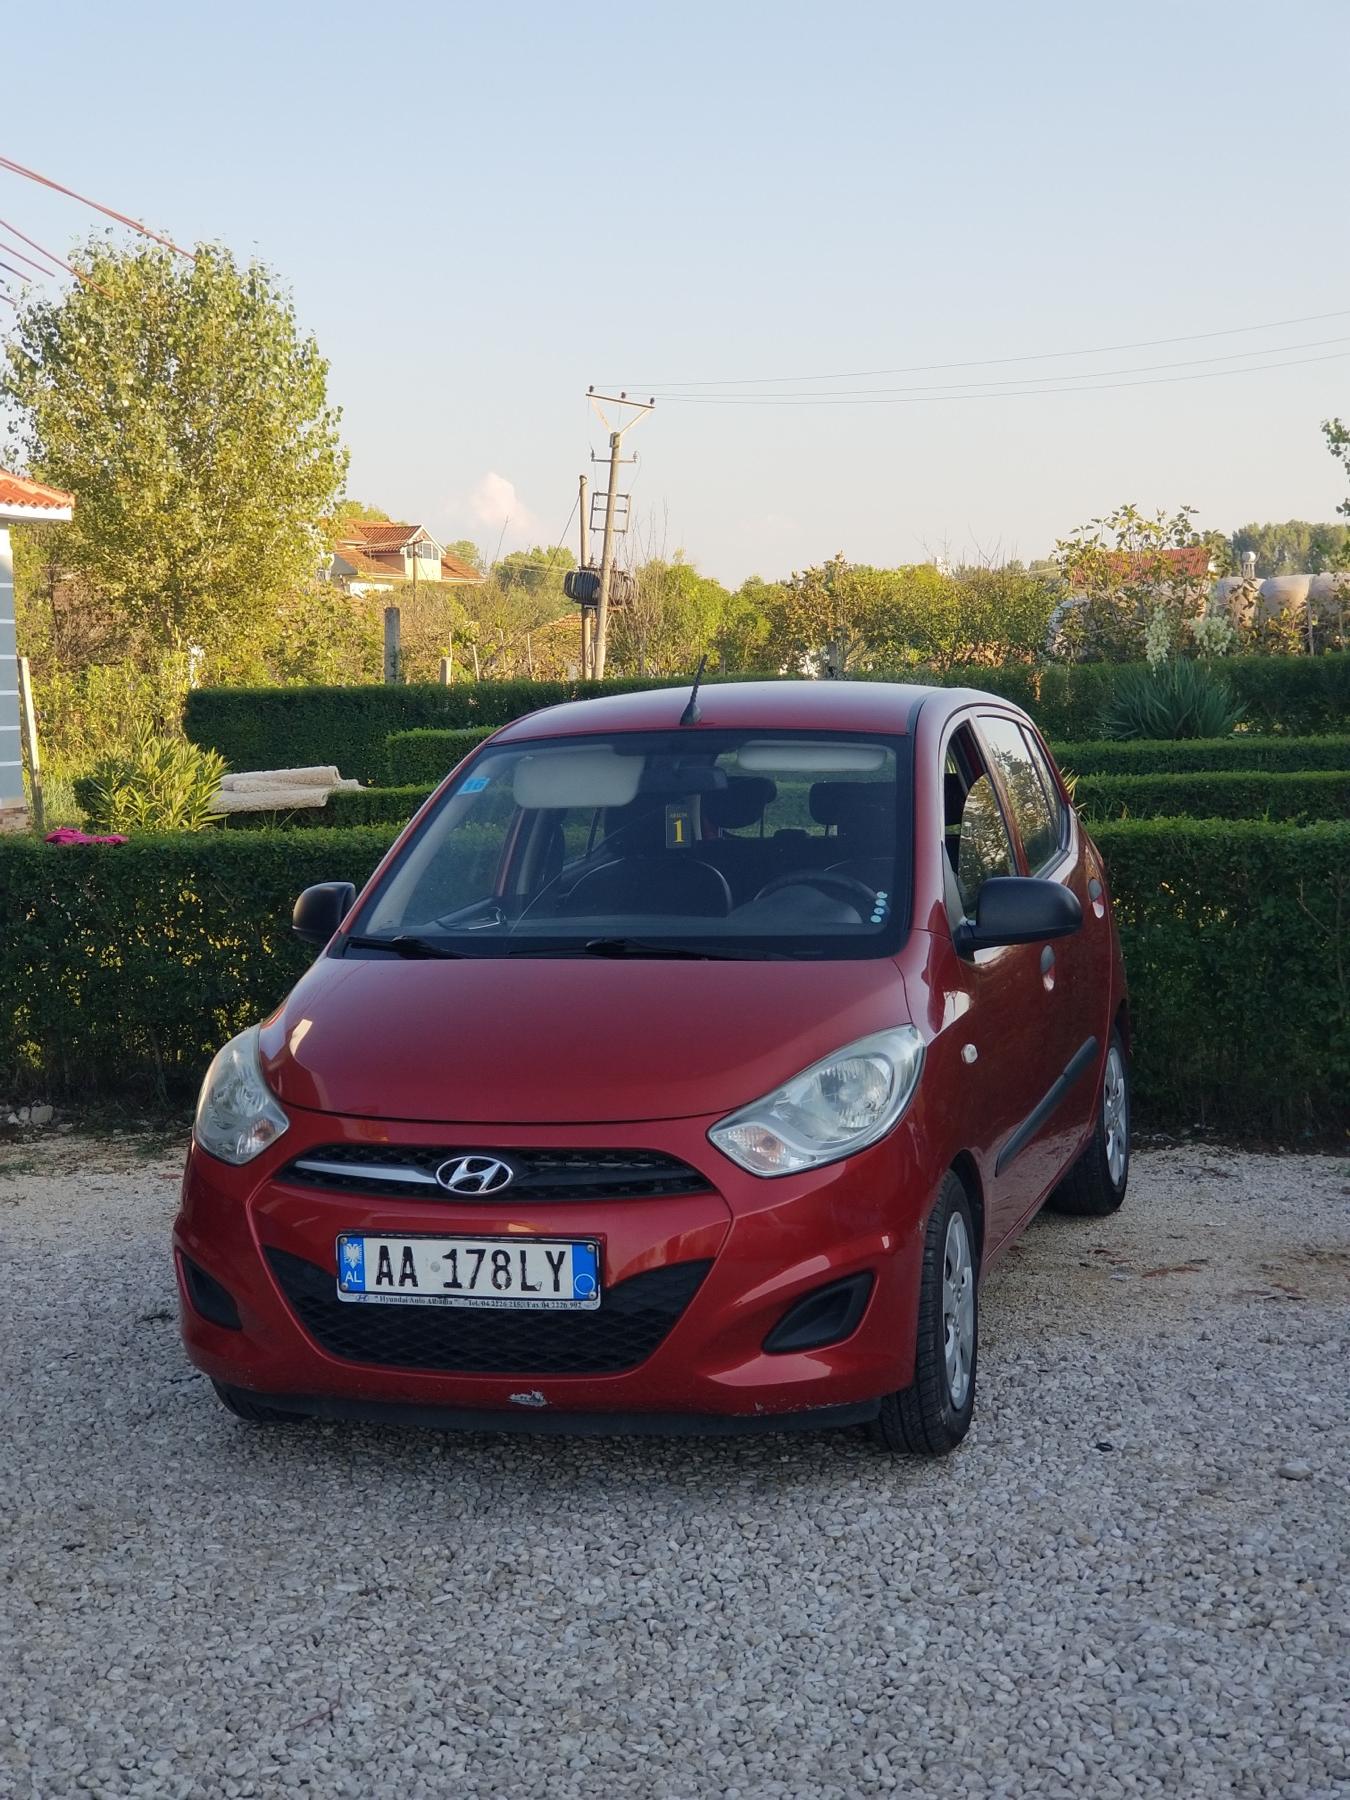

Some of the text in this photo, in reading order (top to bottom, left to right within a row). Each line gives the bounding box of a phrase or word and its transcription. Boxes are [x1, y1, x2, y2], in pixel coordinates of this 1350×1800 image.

[673, 817, 685, 843] 1
[345, 1271, 363, 1283] AL
[375, 1245, 419, 1287] AA
